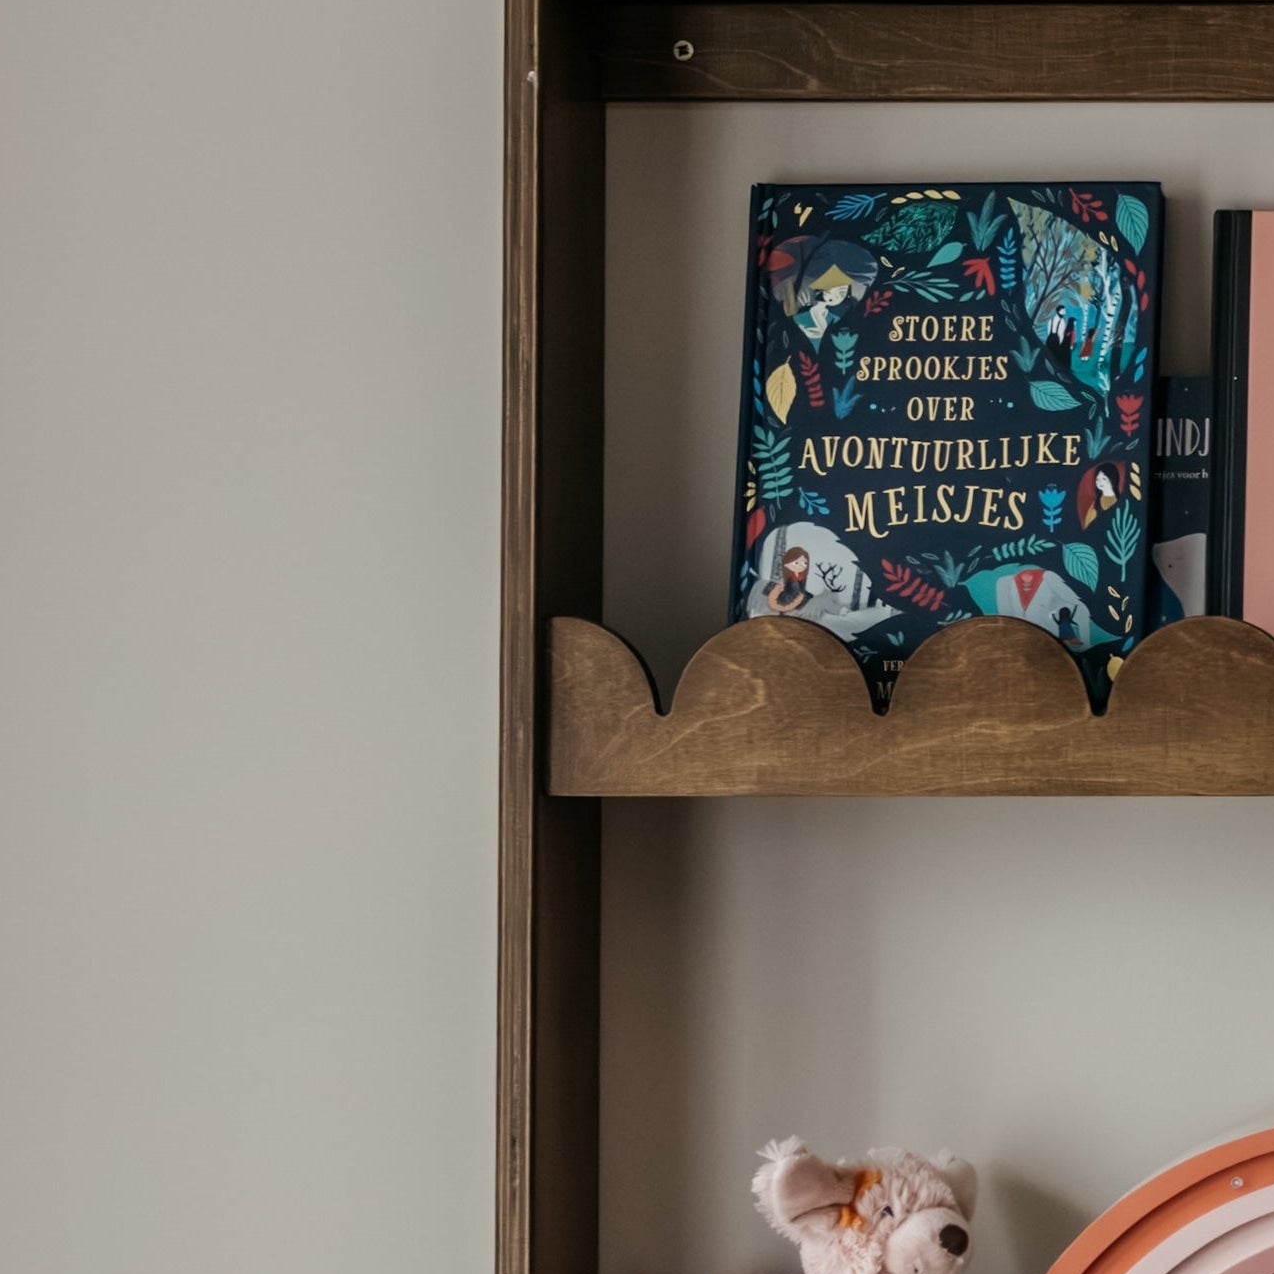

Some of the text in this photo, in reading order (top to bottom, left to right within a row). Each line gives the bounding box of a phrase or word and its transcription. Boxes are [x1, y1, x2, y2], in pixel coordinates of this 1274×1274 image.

[889, 315, 994, 343] STOERE
[856, 355, 1009, 382] SPROOKJES
[906, 396, 975, 422] OVER
[798, 432, 1082, 476] AVONTUURLIJKE
[844, 483, 1027, 539] MEISJES
